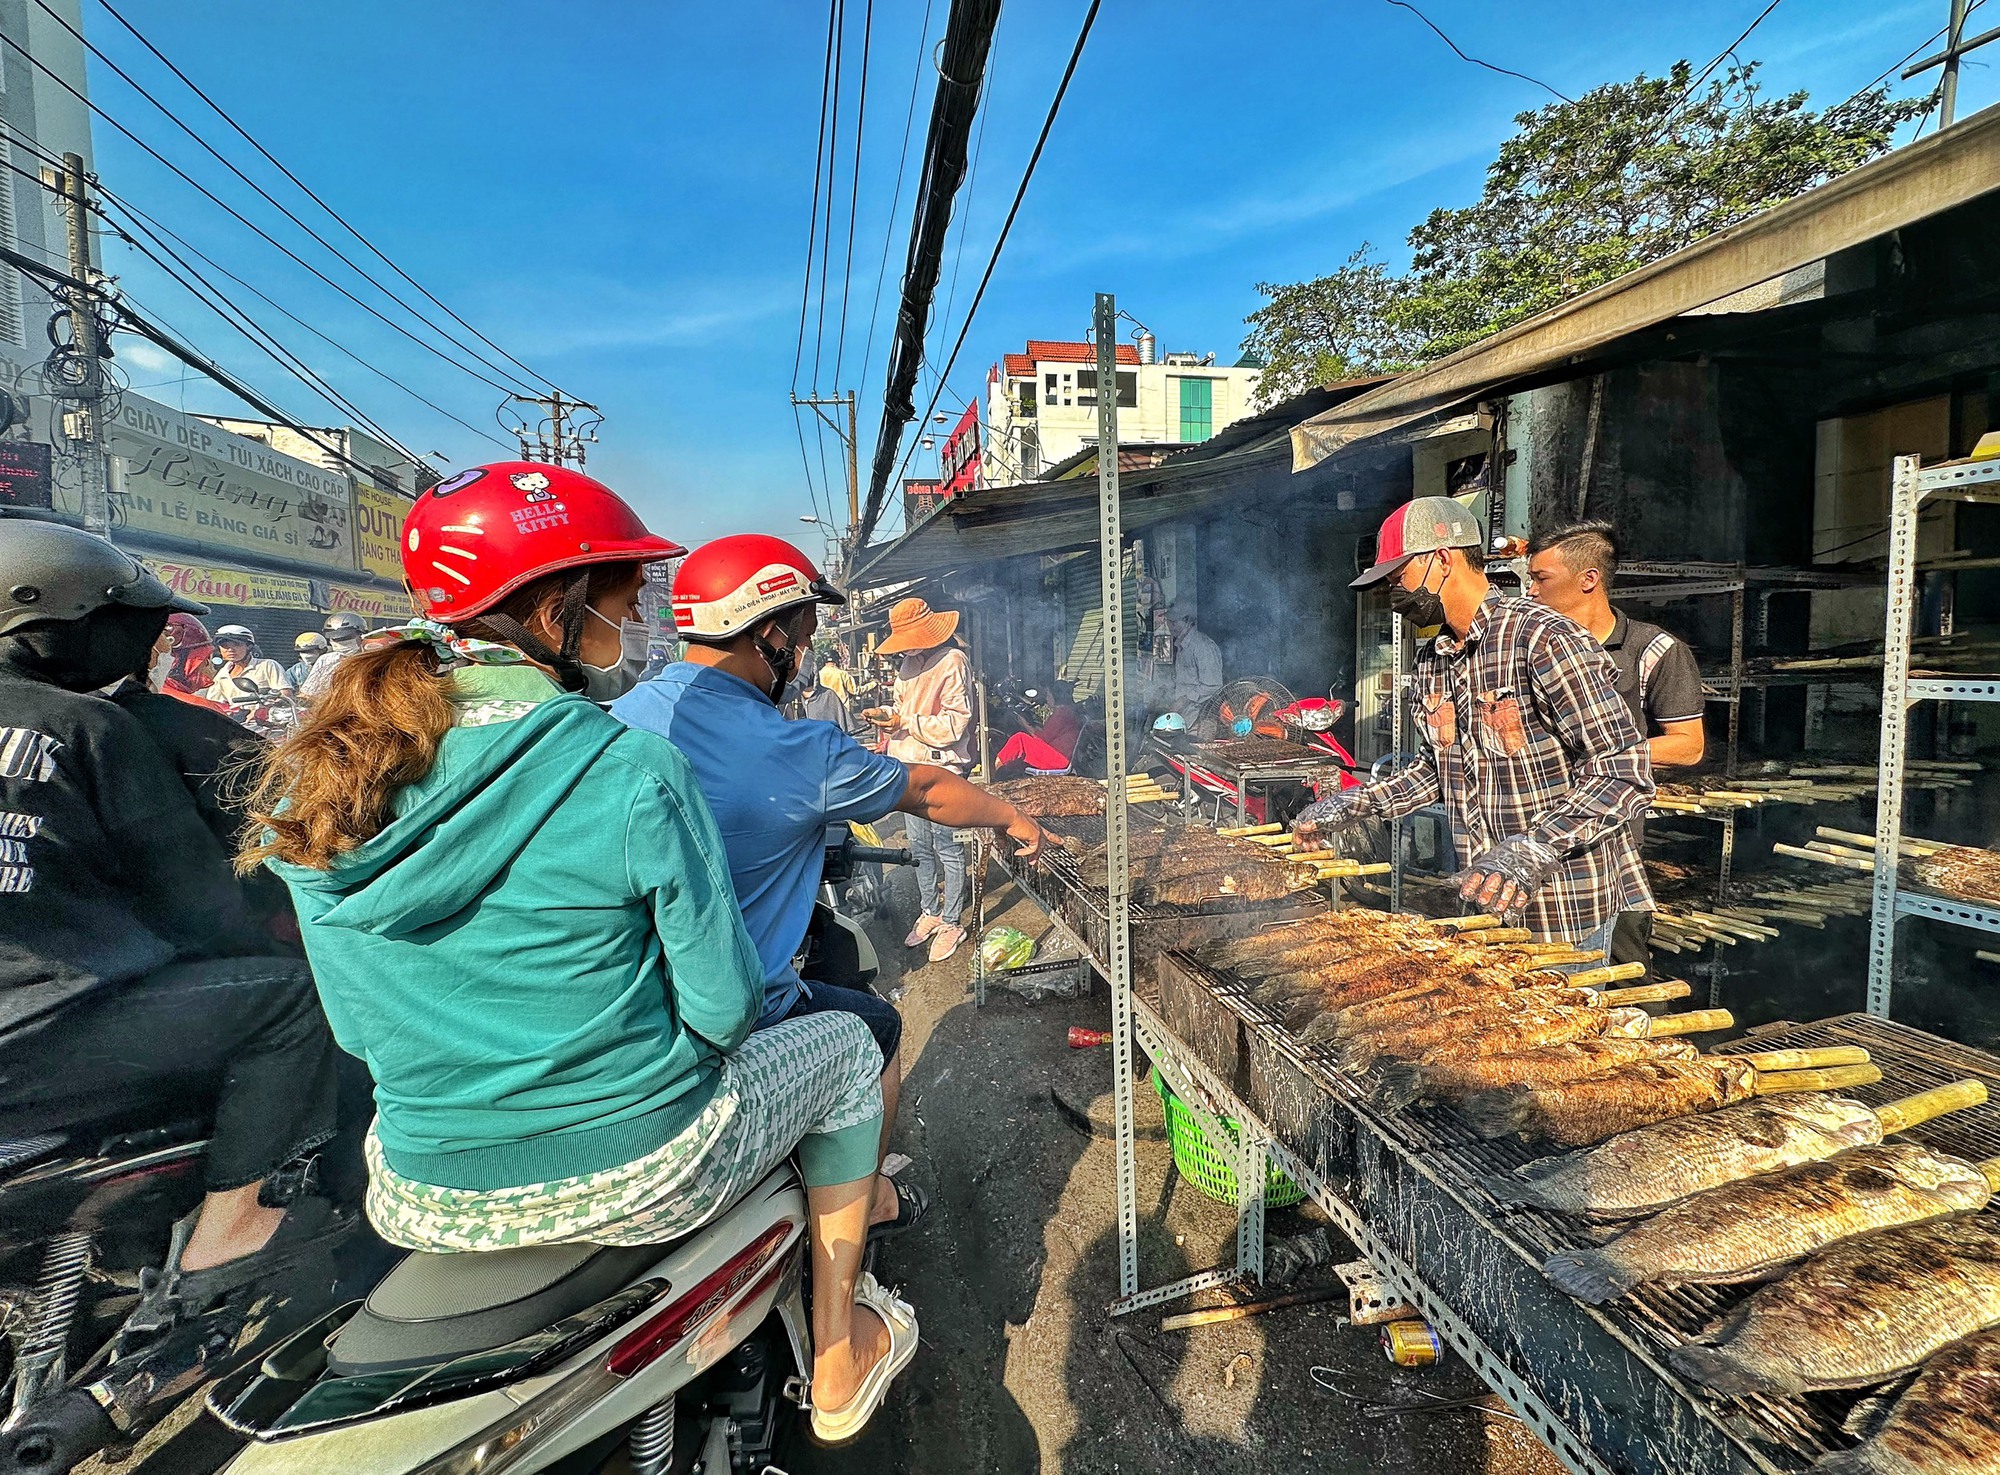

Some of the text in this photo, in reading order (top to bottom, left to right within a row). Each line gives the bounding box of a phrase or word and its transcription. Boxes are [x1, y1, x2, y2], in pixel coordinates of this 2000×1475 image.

[123, 405, 170, 439] GIÀY
[177, 425, 212, 451] DÉP
[227, 444, 253, 468] TÚI
[257, 454, 292, 482] XÁCH
[296, 469, 320, 491] CAO
[323, 477, 344, 499] CẤP
[371, 492, 393, 508] HOUSE
[161, 500, 189, 521] LẺ
[196, 508, 248, 536] BẰNG
[253, 525, 279, 542] GIÁ
[284, 529, 299, 546] SỈ
[510, 501, 566, 523] HELLO
[516, 512, 570, 535] KITTY
[160, 564, 251, 604] Hằng
[779, 588, 790, 596] MÁY
